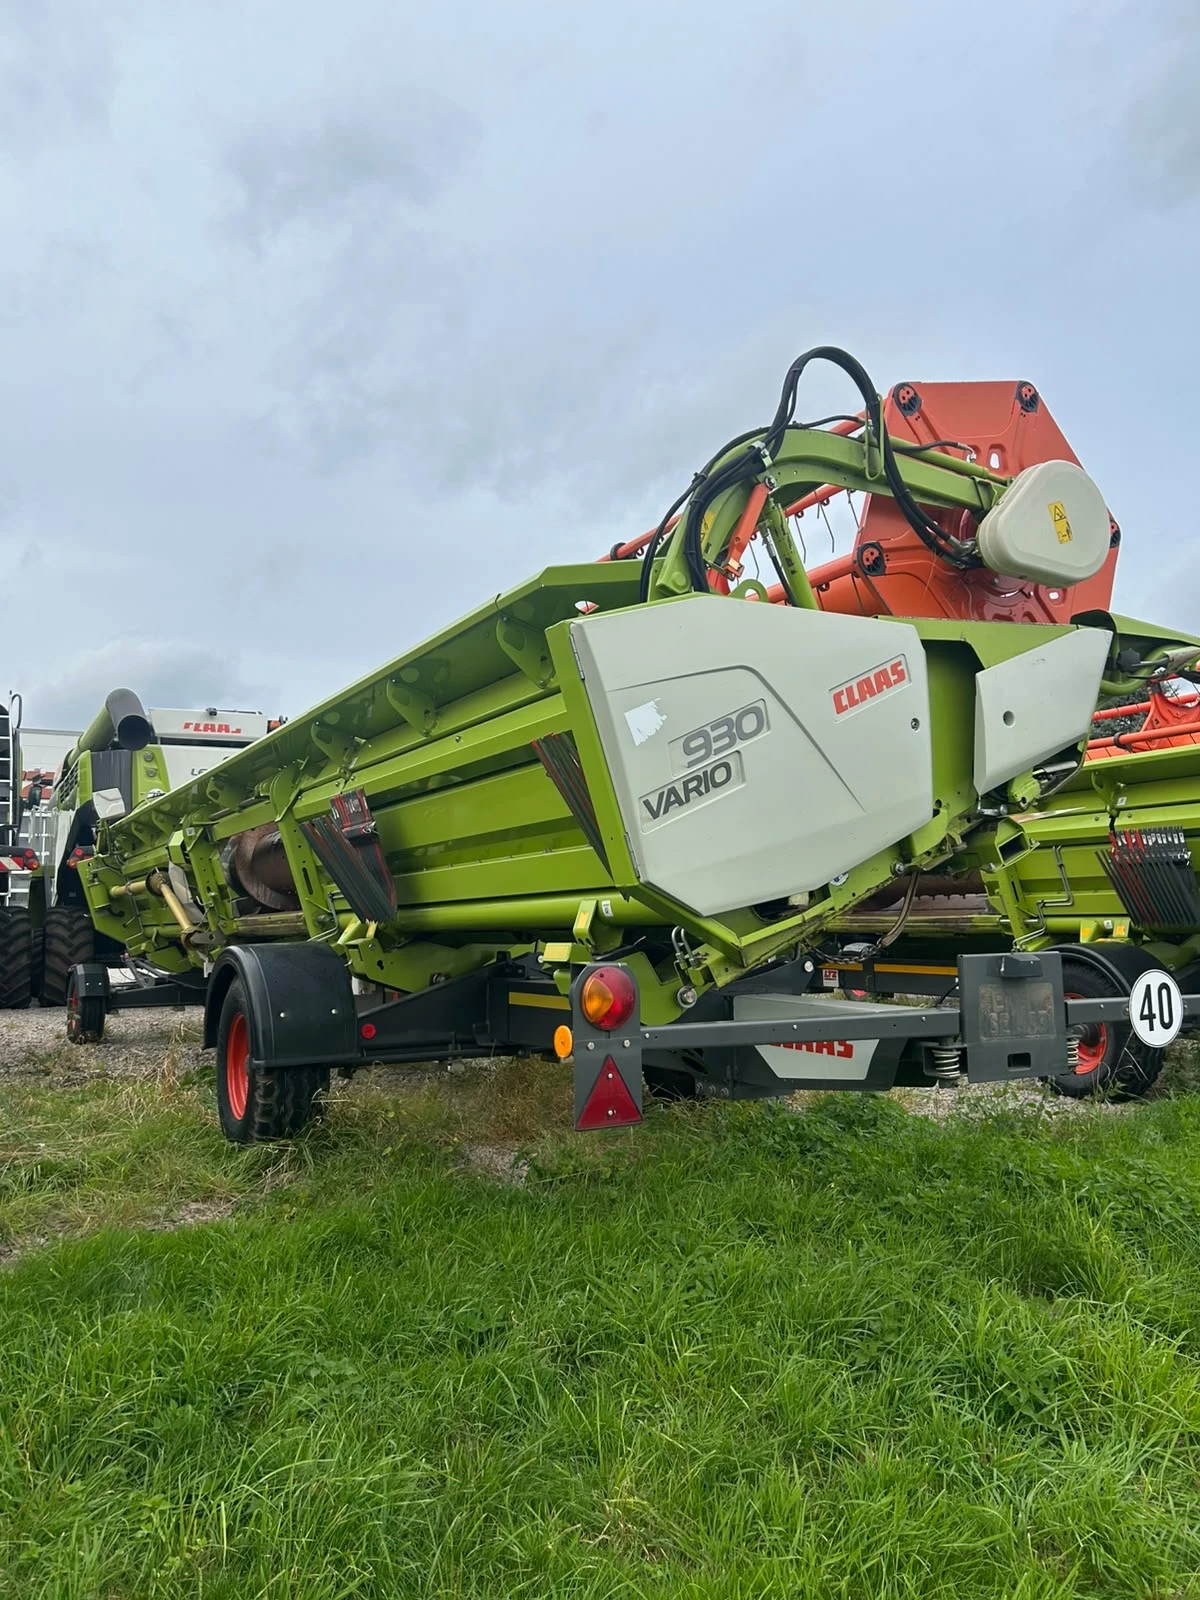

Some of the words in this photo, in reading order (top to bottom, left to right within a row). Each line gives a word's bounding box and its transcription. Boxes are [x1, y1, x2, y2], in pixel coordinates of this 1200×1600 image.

[833, 660, 906, 714] CLAAS
[682, 705, 765, 769] 930
[642, 761, 732, 820] VARIO
[1139, 982, 1174, 1032] 40
